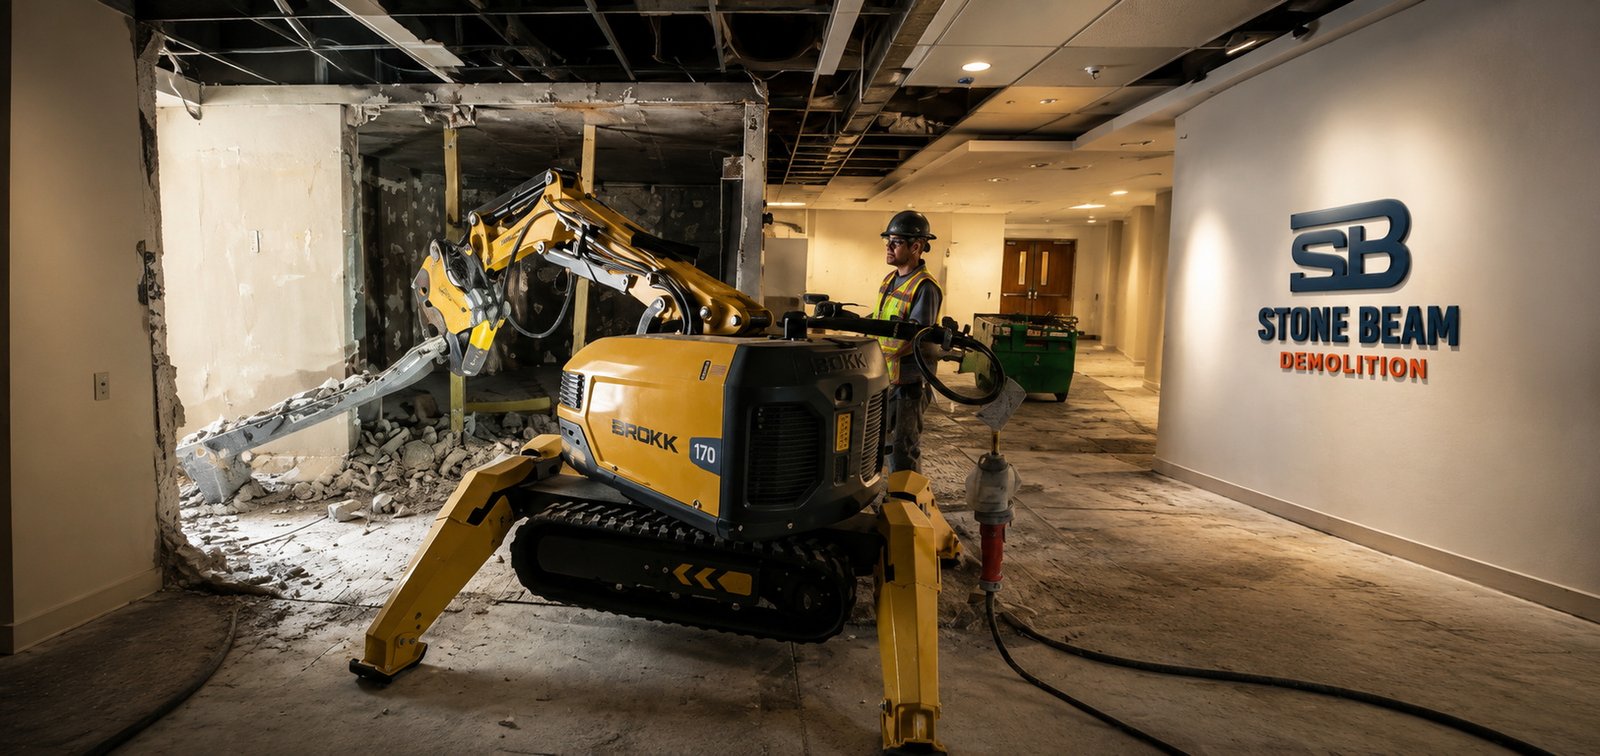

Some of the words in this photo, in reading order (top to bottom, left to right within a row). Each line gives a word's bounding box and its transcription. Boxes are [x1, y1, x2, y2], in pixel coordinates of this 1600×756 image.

[1290, 198, 1411, 292] SB
[1258, 307, 1349, 342] STONE
[1359, 305, 1459, 346] BEAM
[1280, 351, 1427, 379] DEMOLITION
[611, 418, 679, 453] BROKK
[693, 443, 716, 464] 170
